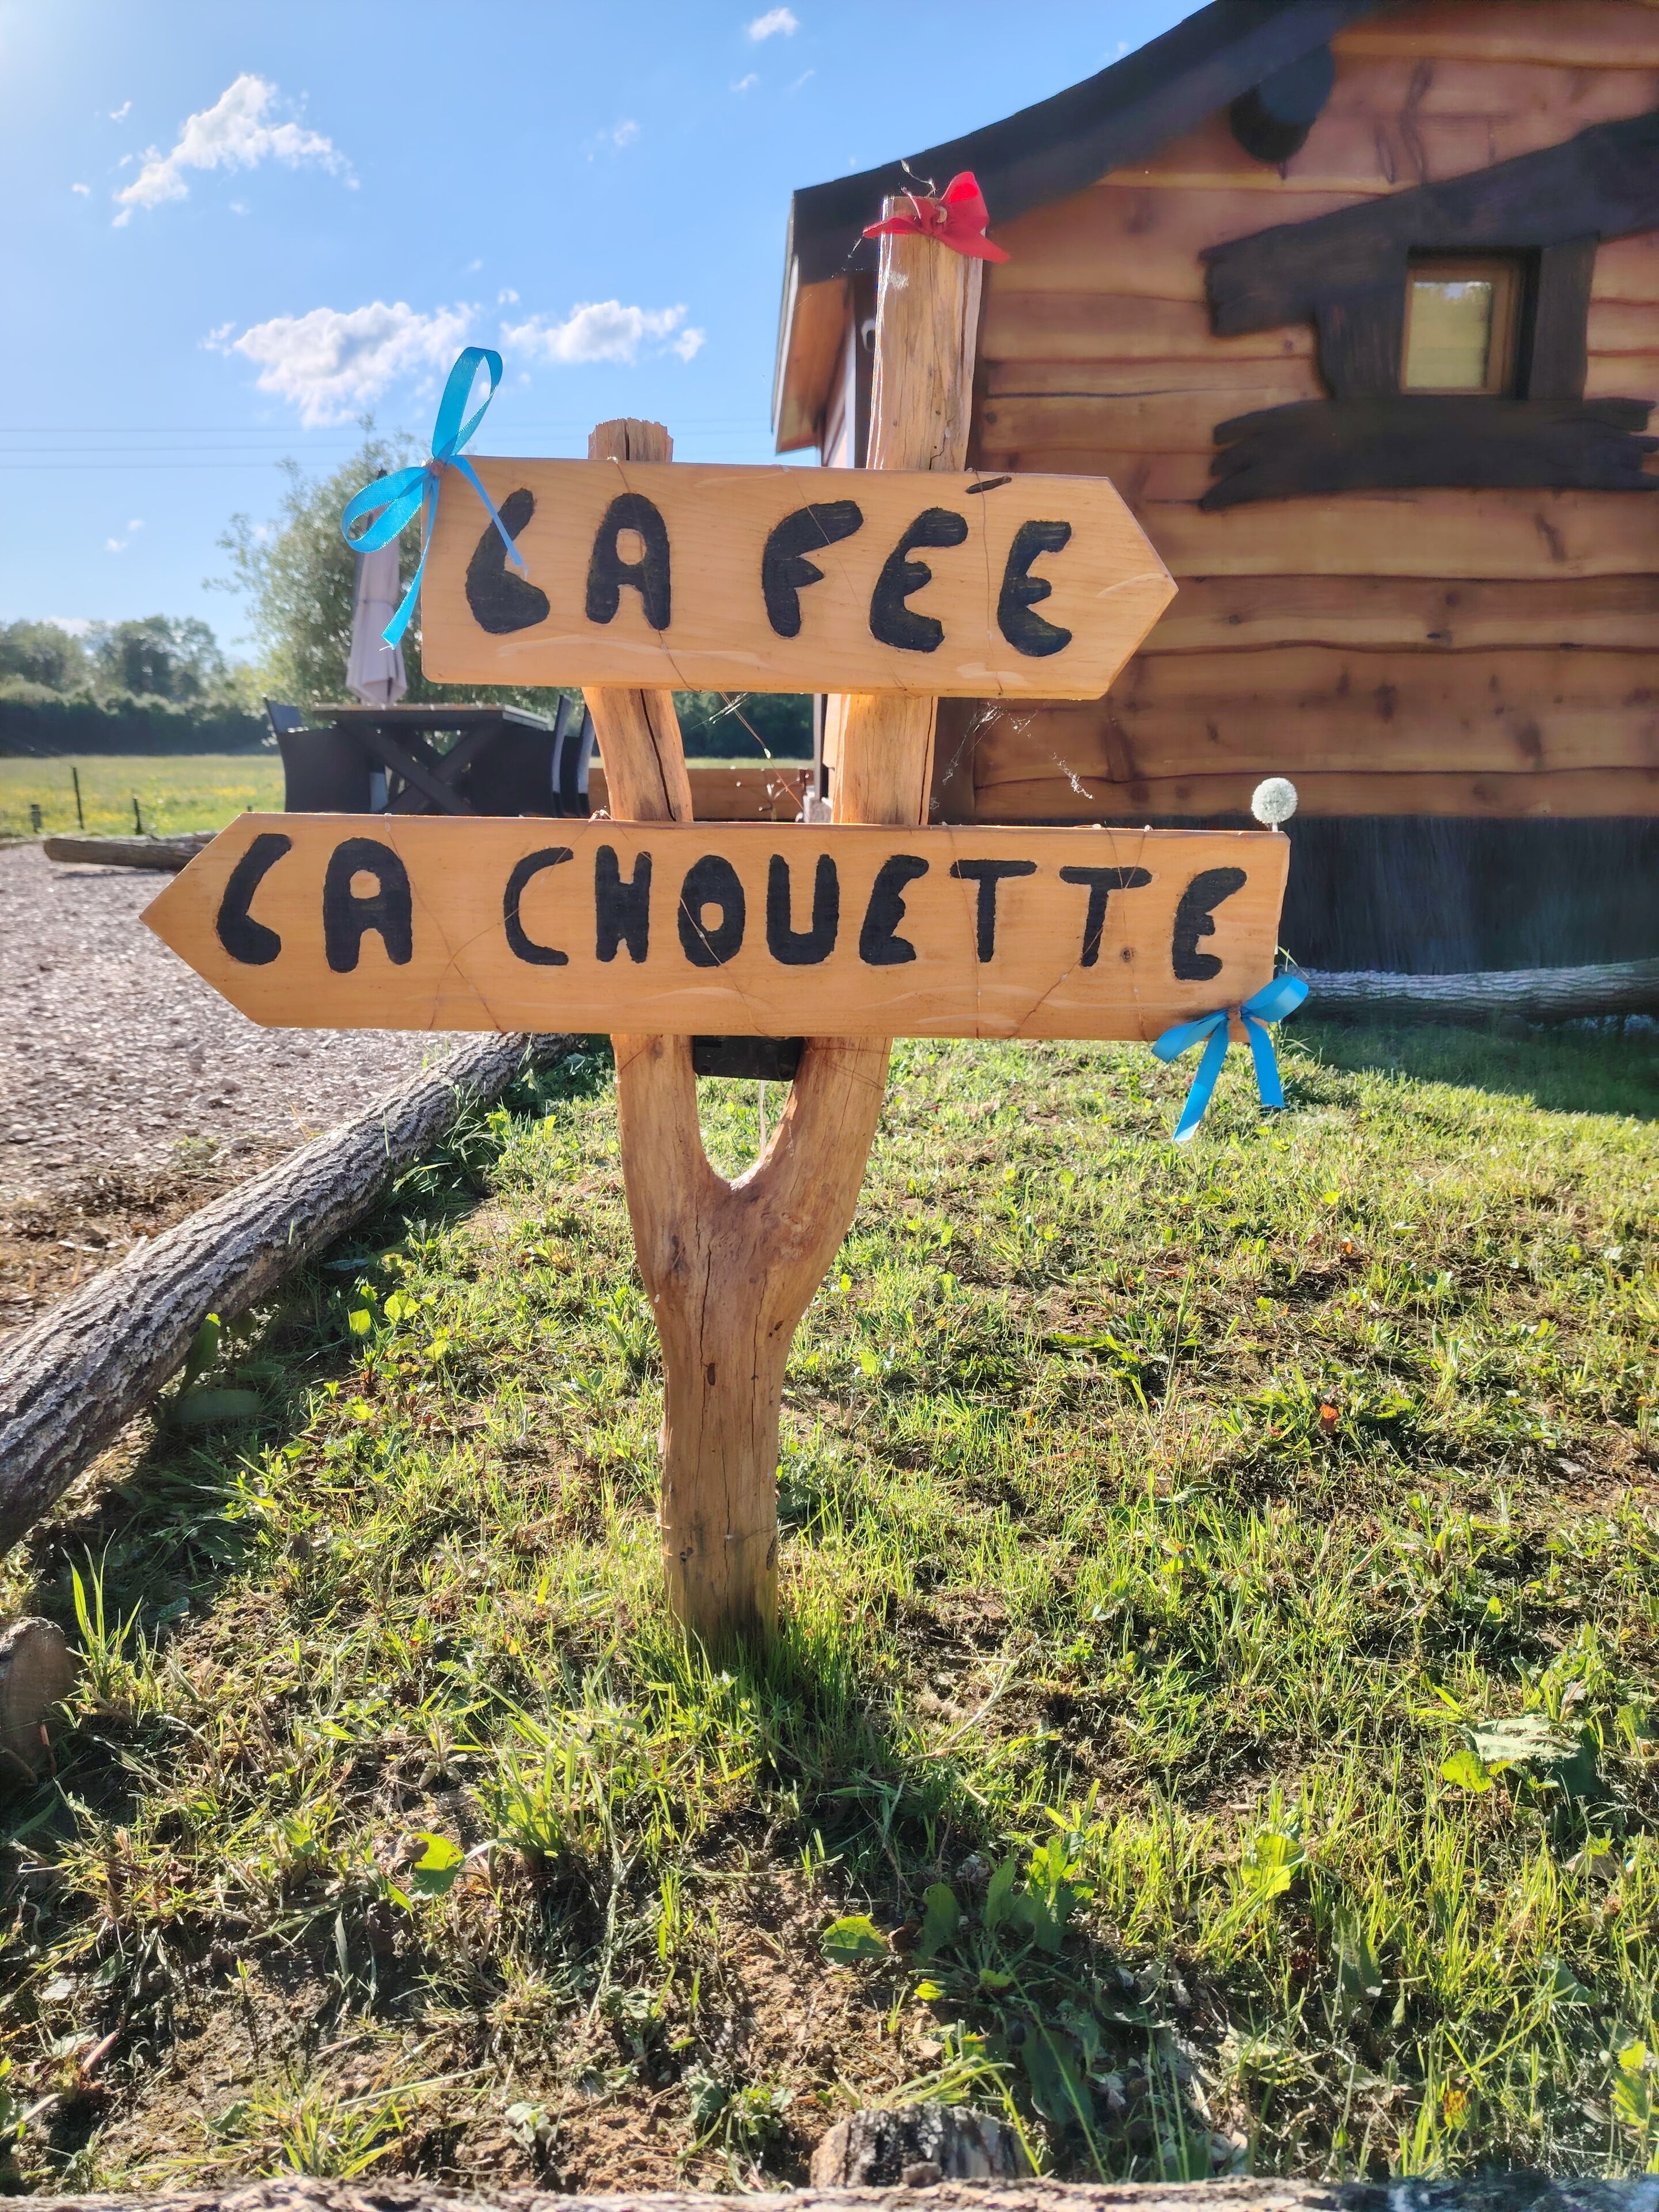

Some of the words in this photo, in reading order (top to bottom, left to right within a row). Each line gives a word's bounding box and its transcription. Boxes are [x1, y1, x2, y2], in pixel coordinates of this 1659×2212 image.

[465, 487, 672, 635] LA
[217, 833, 413, 974] LA
[503, 844, 1248, 982] CHOUETTE
